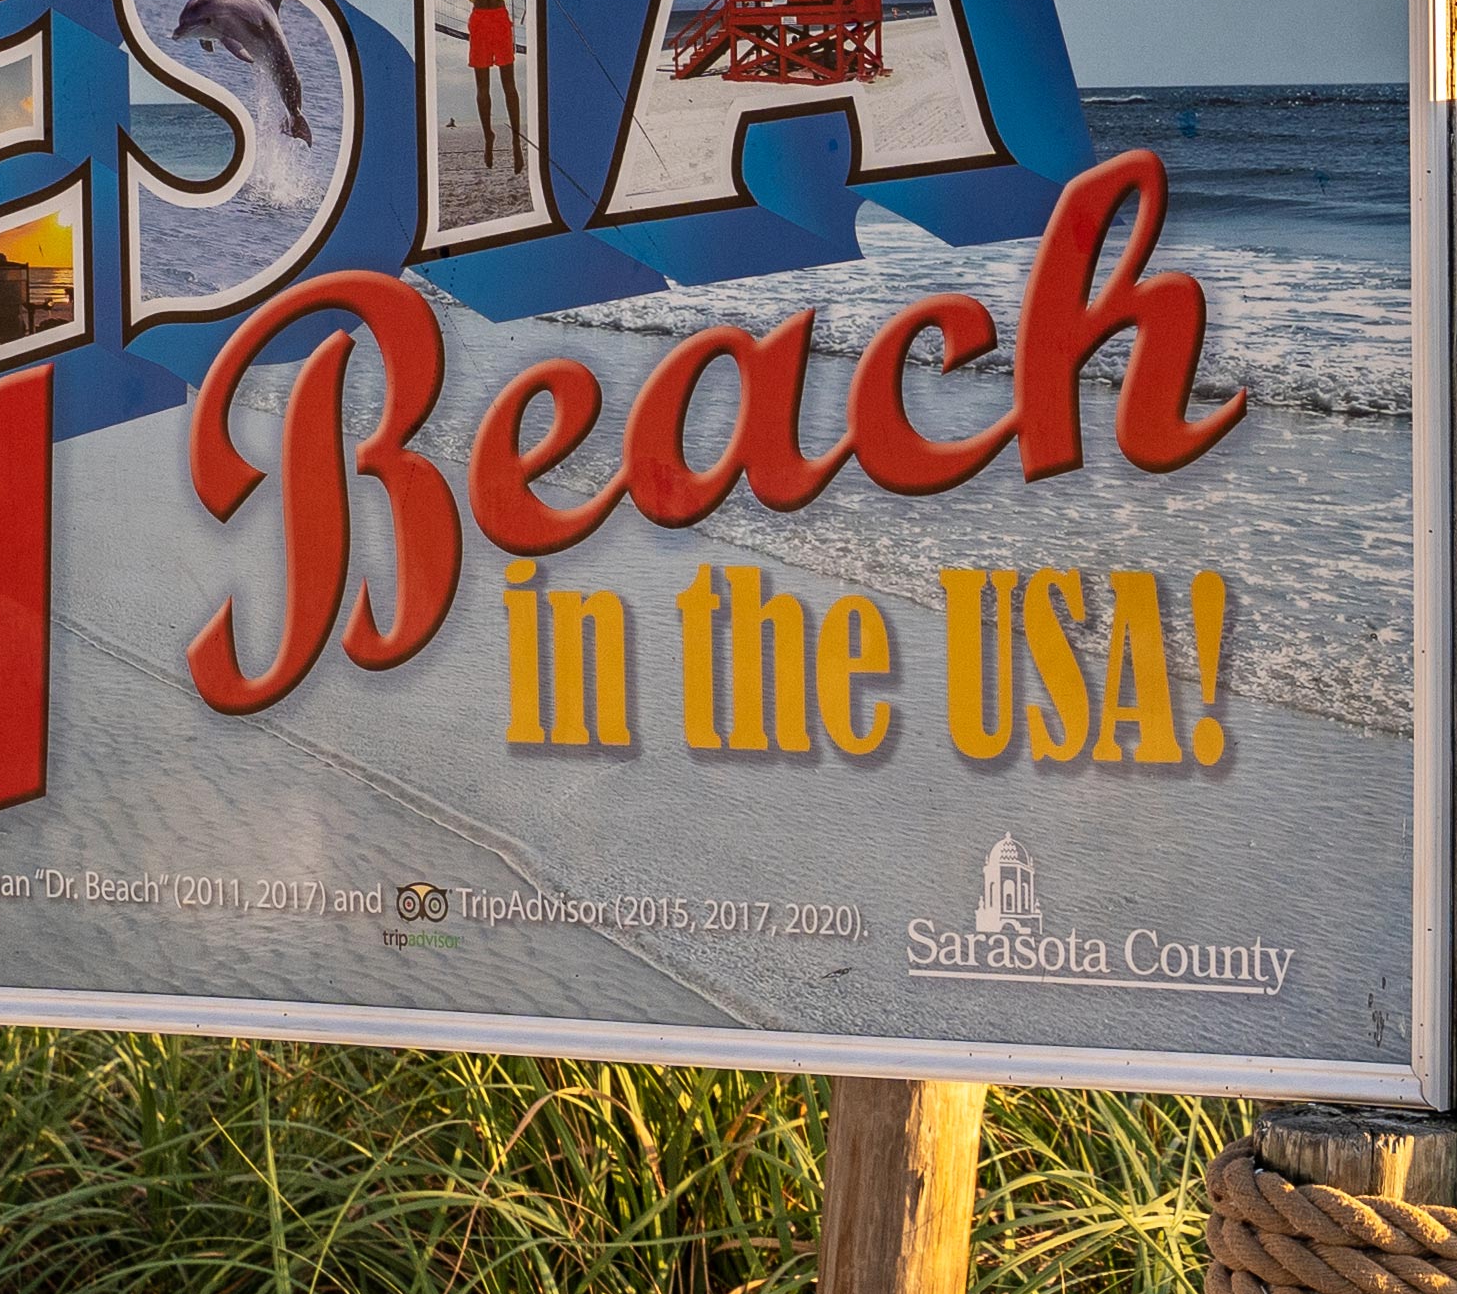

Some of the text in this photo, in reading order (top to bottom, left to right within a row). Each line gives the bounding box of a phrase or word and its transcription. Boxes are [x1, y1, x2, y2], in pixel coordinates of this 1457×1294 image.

[186, 148, 1248, 716] Beach
[502, 559, 1226, 767] in the USA!
[174, 874, 250, 912] (2011,
[256, 879, 327, 916] 2017)
[333, 882, 383, 914] and
[455, 887, 606, 928] TripAdvisor
[614, 895, 696, 933] (2015,
[703, 898, 777, 937] 2017,
[784, 903, 869, 941] 2020).
[382, 928, 461, 951] tripadvisor
[906, 917, 1295, 996] Sarasota County
